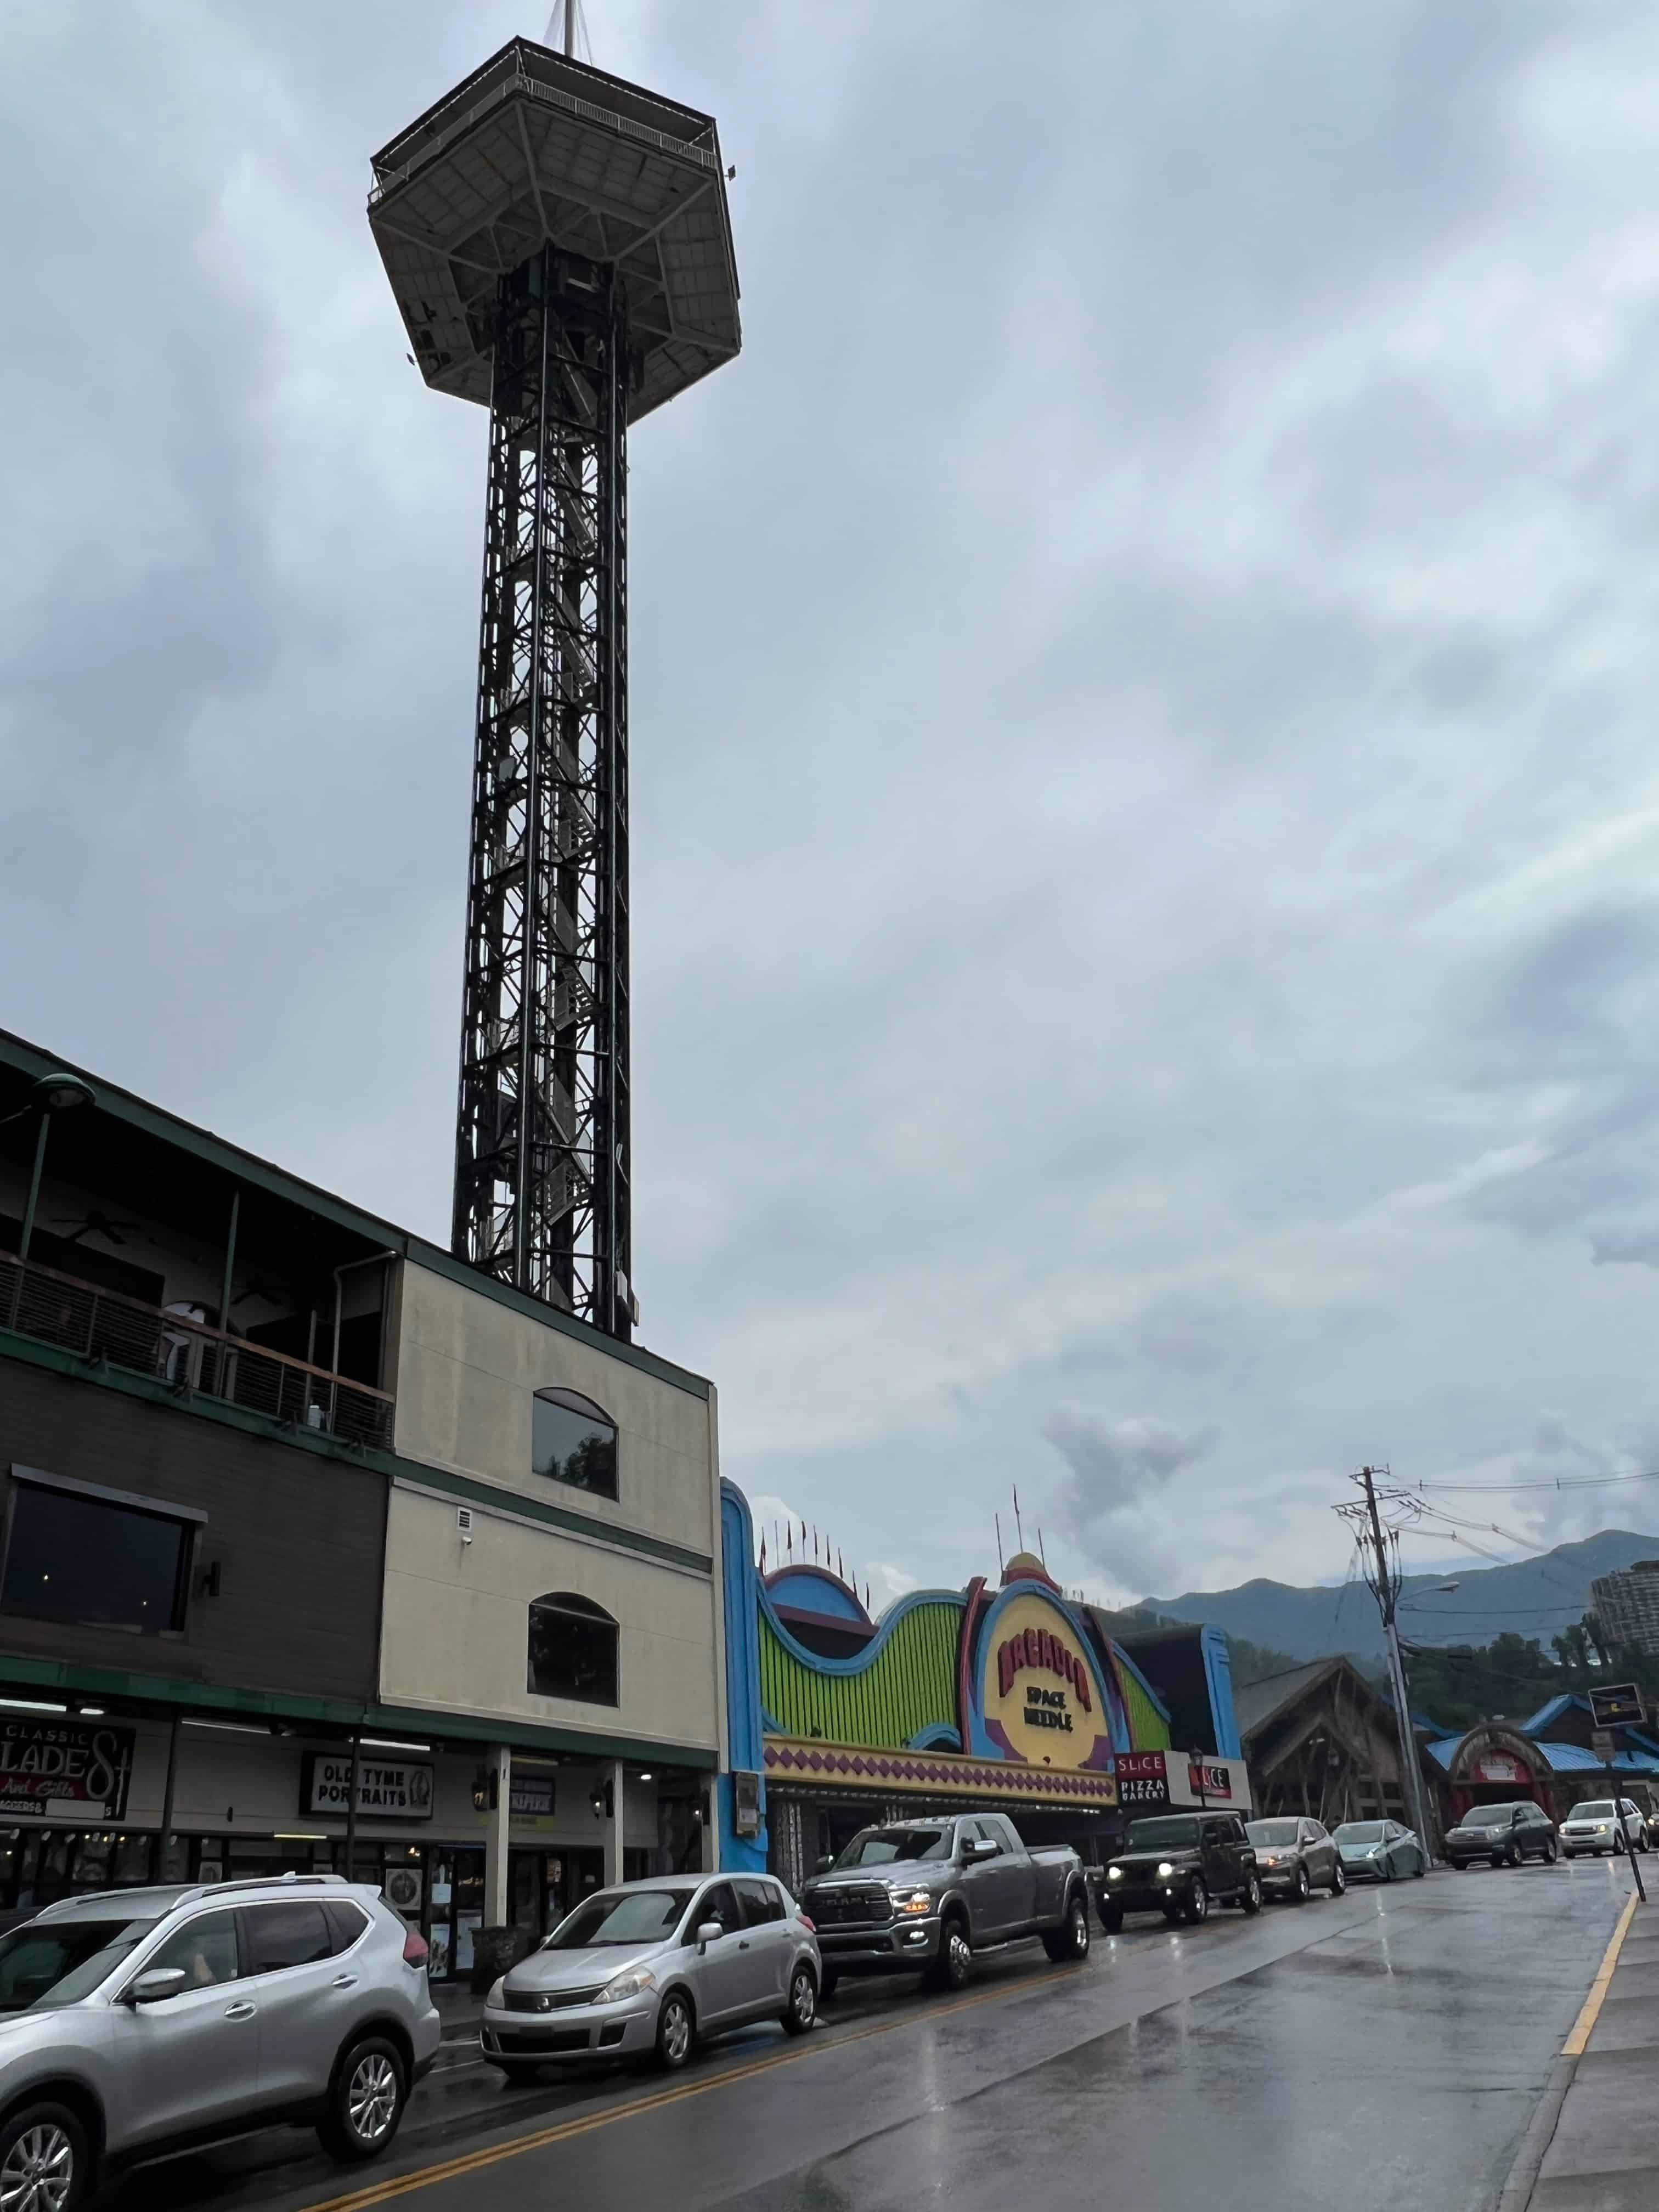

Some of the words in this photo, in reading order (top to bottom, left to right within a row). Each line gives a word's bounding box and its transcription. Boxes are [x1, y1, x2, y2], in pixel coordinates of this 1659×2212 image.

[5, 1724, 88, 1745] CLASSIC
[0, 1730, 117, 1799] LADES
[1, 1775, 31, 1795] And
[35, 1779, 75, 1798] Gifts
[364, 1768, 404, 1787] TYME
[1121, 1779, 1164, 1791] PIZZA
[318, 1785, 406, 1806] PORRAITS
